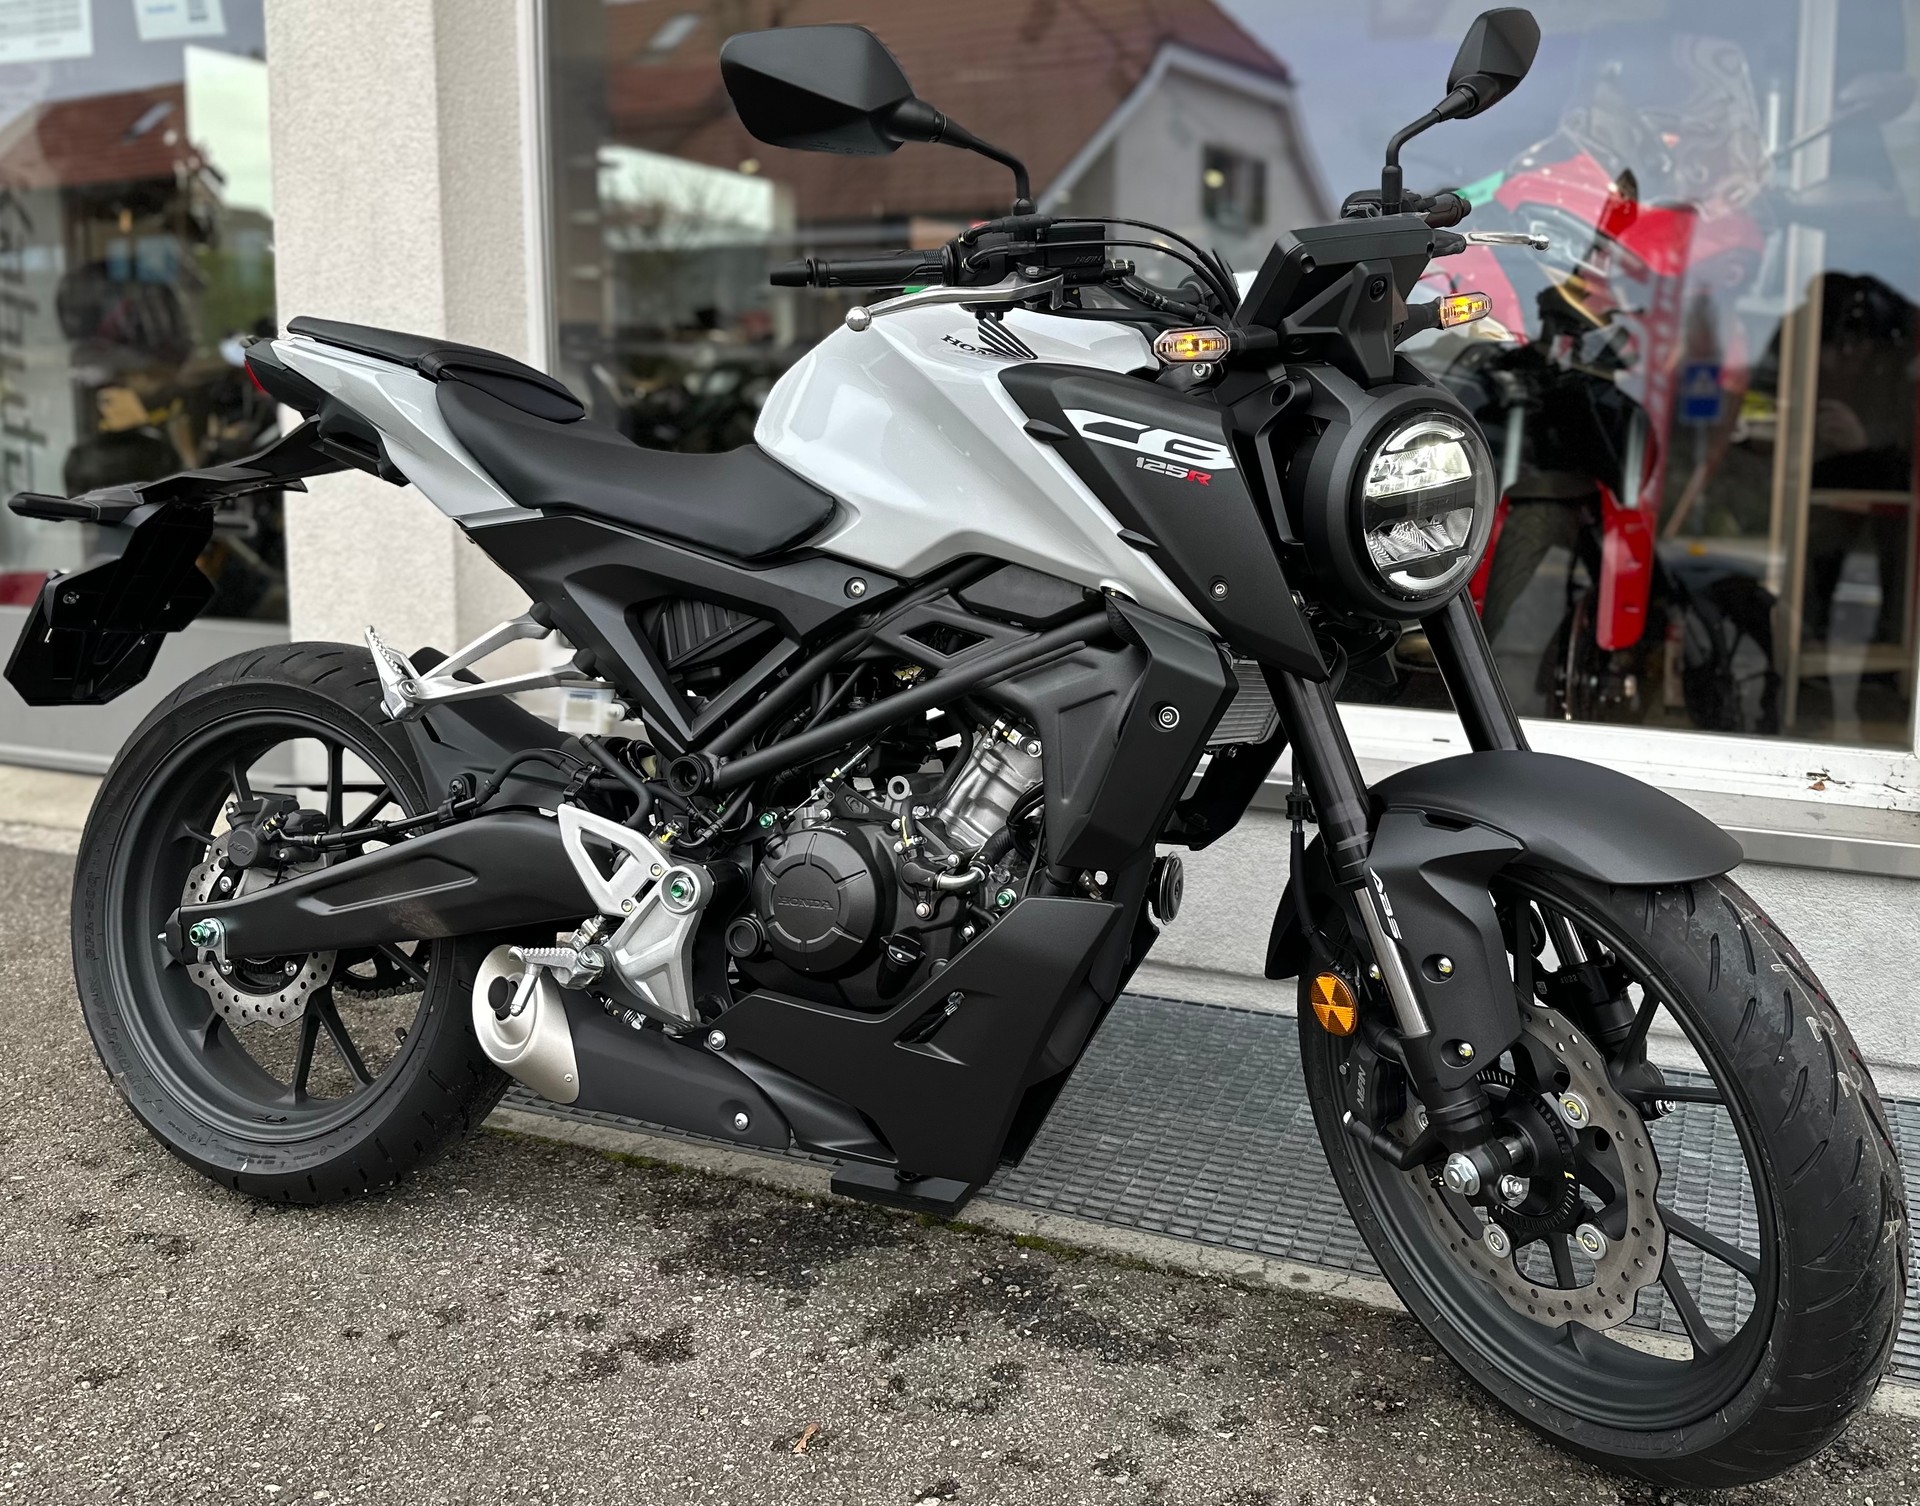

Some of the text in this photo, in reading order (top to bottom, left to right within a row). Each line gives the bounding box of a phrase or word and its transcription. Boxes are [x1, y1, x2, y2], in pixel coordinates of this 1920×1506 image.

[1062, 408, 1236, 470] CB
[1135, 456, 1213, 487] 125R
[777, 895, 834, 911] HONDA
[1369, 866, 1403, 940] ABS
